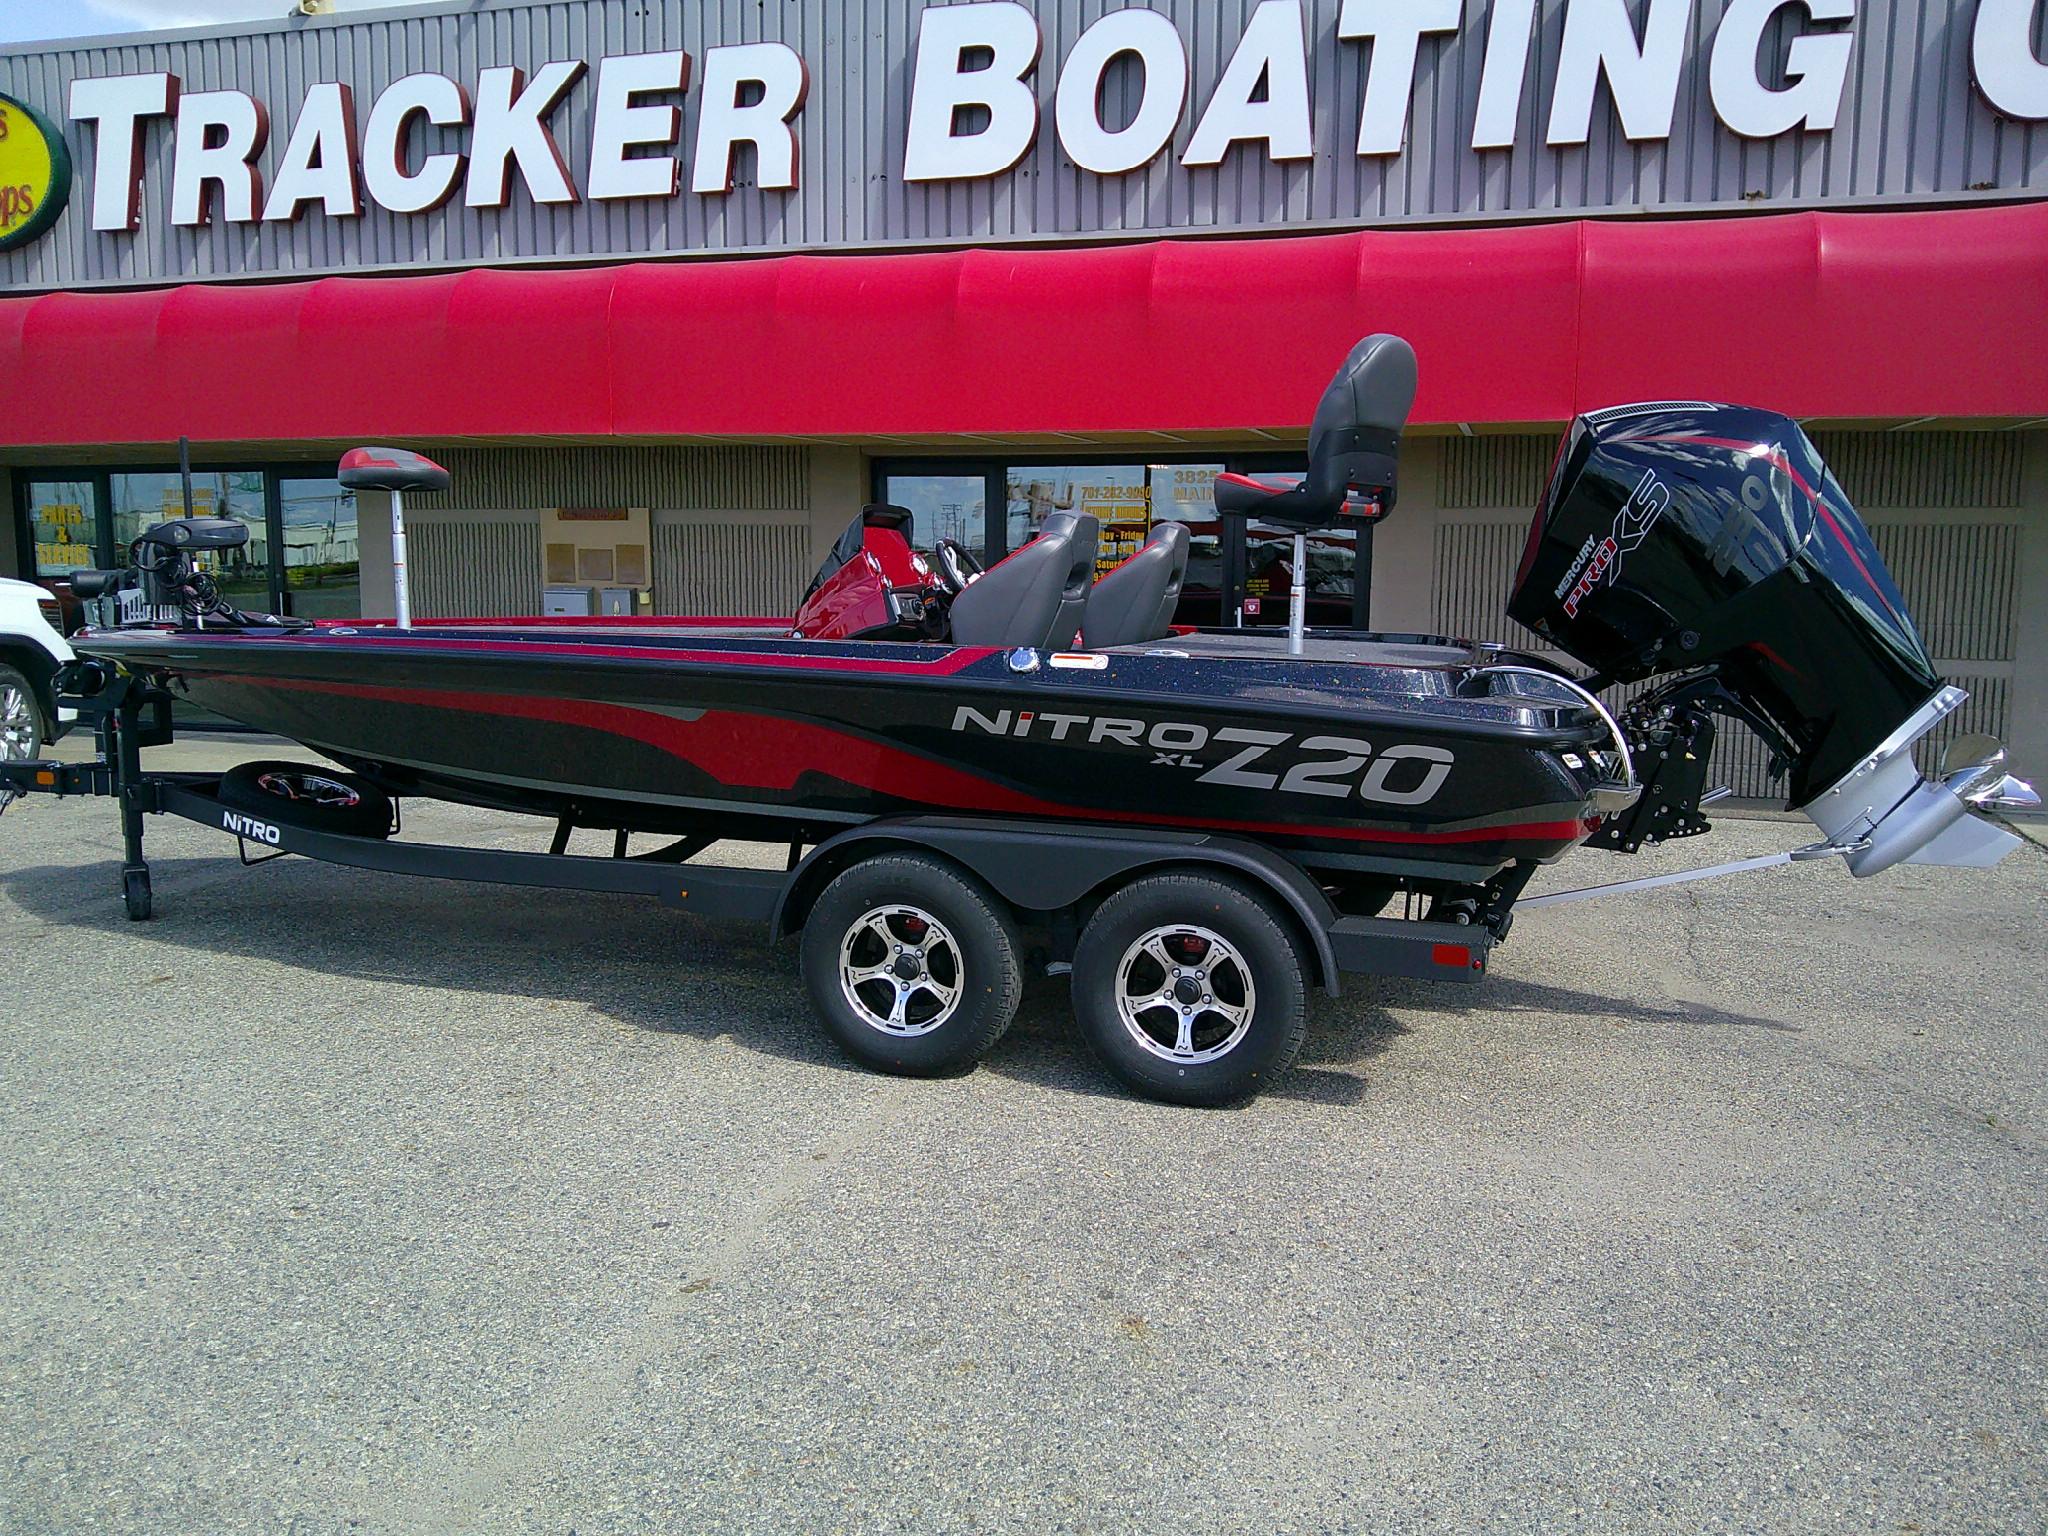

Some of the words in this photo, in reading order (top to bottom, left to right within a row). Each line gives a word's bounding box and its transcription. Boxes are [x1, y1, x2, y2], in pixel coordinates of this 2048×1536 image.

[68, 41, 809, 232] TRACKER
[903, 0, 1856, 183] BOATING
[1554, 533, 1597, 599] MERCURY
[1563, 536, 1618, 619] PRO
[1609, 468, 1670, 587] XS
[1150, 752, 1204, 769] XL
[1195, 727, 1455, 805] Z20
